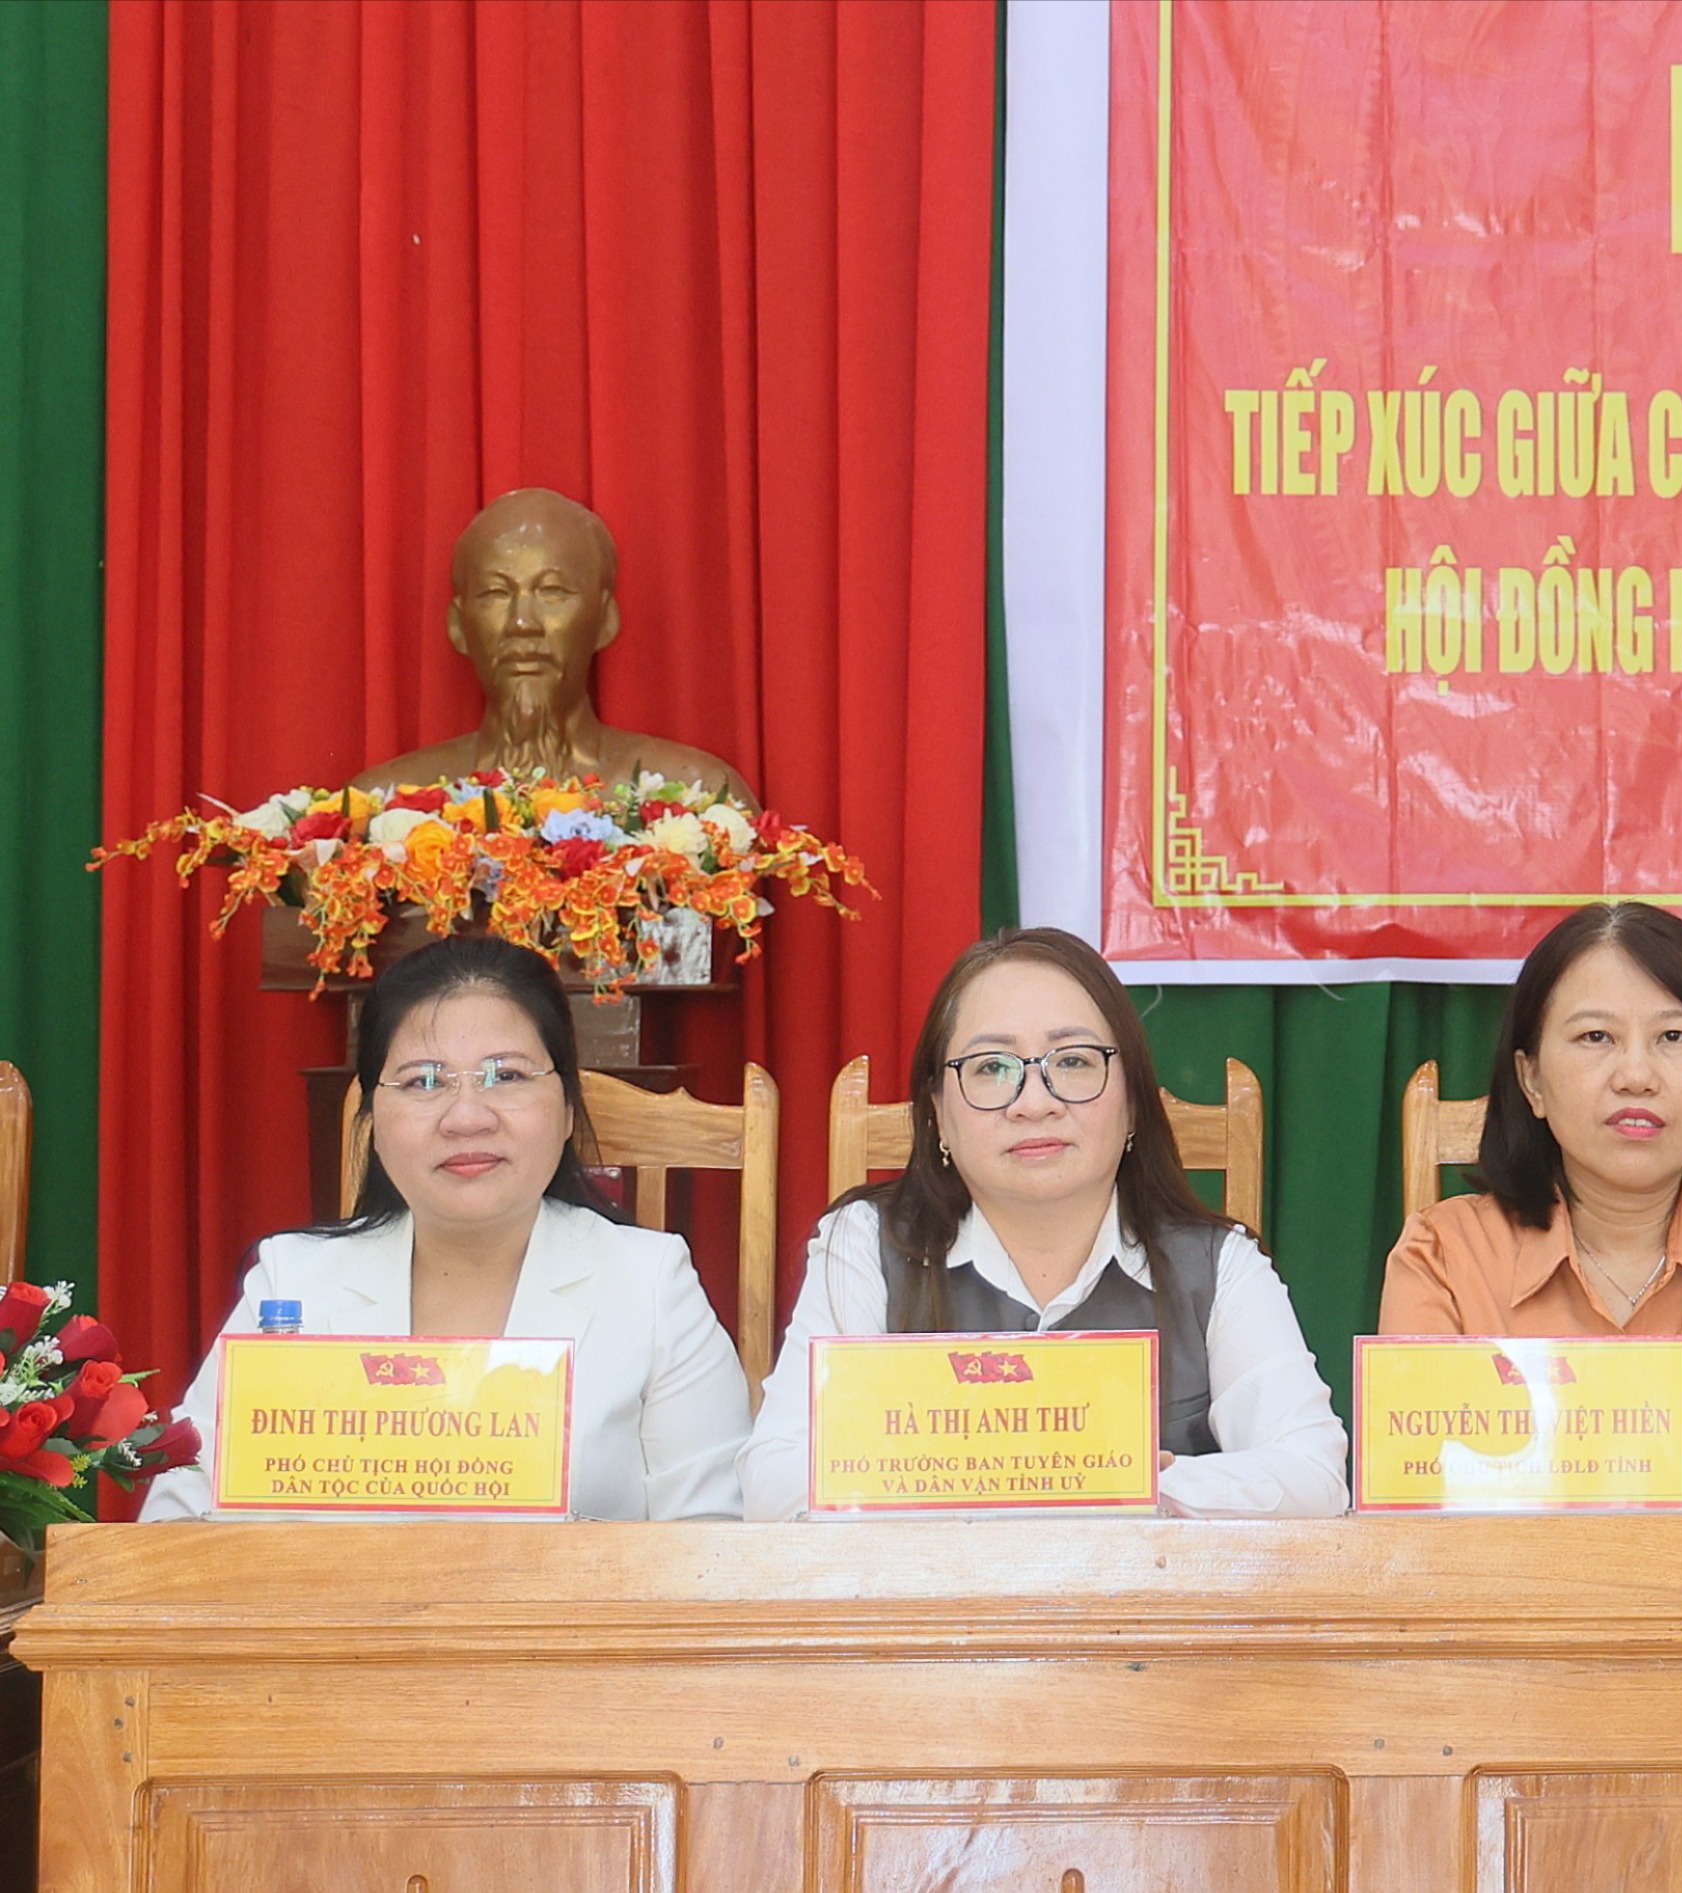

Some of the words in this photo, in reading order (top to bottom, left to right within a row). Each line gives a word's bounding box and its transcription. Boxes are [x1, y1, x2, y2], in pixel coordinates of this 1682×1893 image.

[1225, 358, 1355, 496] TIẾP
[1367, 366, 1482, 498] XÚC
[1498, 366, 1635, 498] GIỮA
[1385, 544, 1482, 696] HỘI
[1498, 535, 1654, 675] ĐỒNG
[251, 1409, 315, 1434] ĐINH
[323, 1409, 367, 1442] THỊ
[374, 1406, 482, 1437] PHƯƠNG
[490, 1412, 541, 1438] LAN
[885, 1402, 919, 1435] HÀ
[927, 1408, 971, 1440] THỊ
[976, 1407, 1029, 1434] ANH
[1036, 1402, 1090, 1432] THƯ
[1388, 1403, 1491, 1436] NGUYỄN
[1551, 1406, 1605, 1441] VIỆT
[265, 1454, 306, 1472] PHÓ
[312, 1455, 354, 1473] CHỦ
[360, 1458, 408, 1477] TỊCH
[414, 1457, 450, 1477] HỘI
[830, 1455, 870, 1473] PHÓ
[876, 1453, 959, 1472] TRƯỞNG
[965, 1455, 1005, 1471] BAN
[1011, 1451, 1076, 1470] TUYÊN
[1083, 1449, 1133, 1469] GIÁO
[1403, 1456, 1443, 1475] PHÓ
[1605, 1456, 1652, 1473] TỈNH
[272, 1475, 312, 1494] DÂN
[365, 1477, 406, 1495] CỦA
[474, 1480, 510, 1499] HỘI
[882, 1475, 909, 1493] VÀ
[915, 1475, 955, 1493] DÂN
[1007, 1474, 1054, 1491] TỈNH
